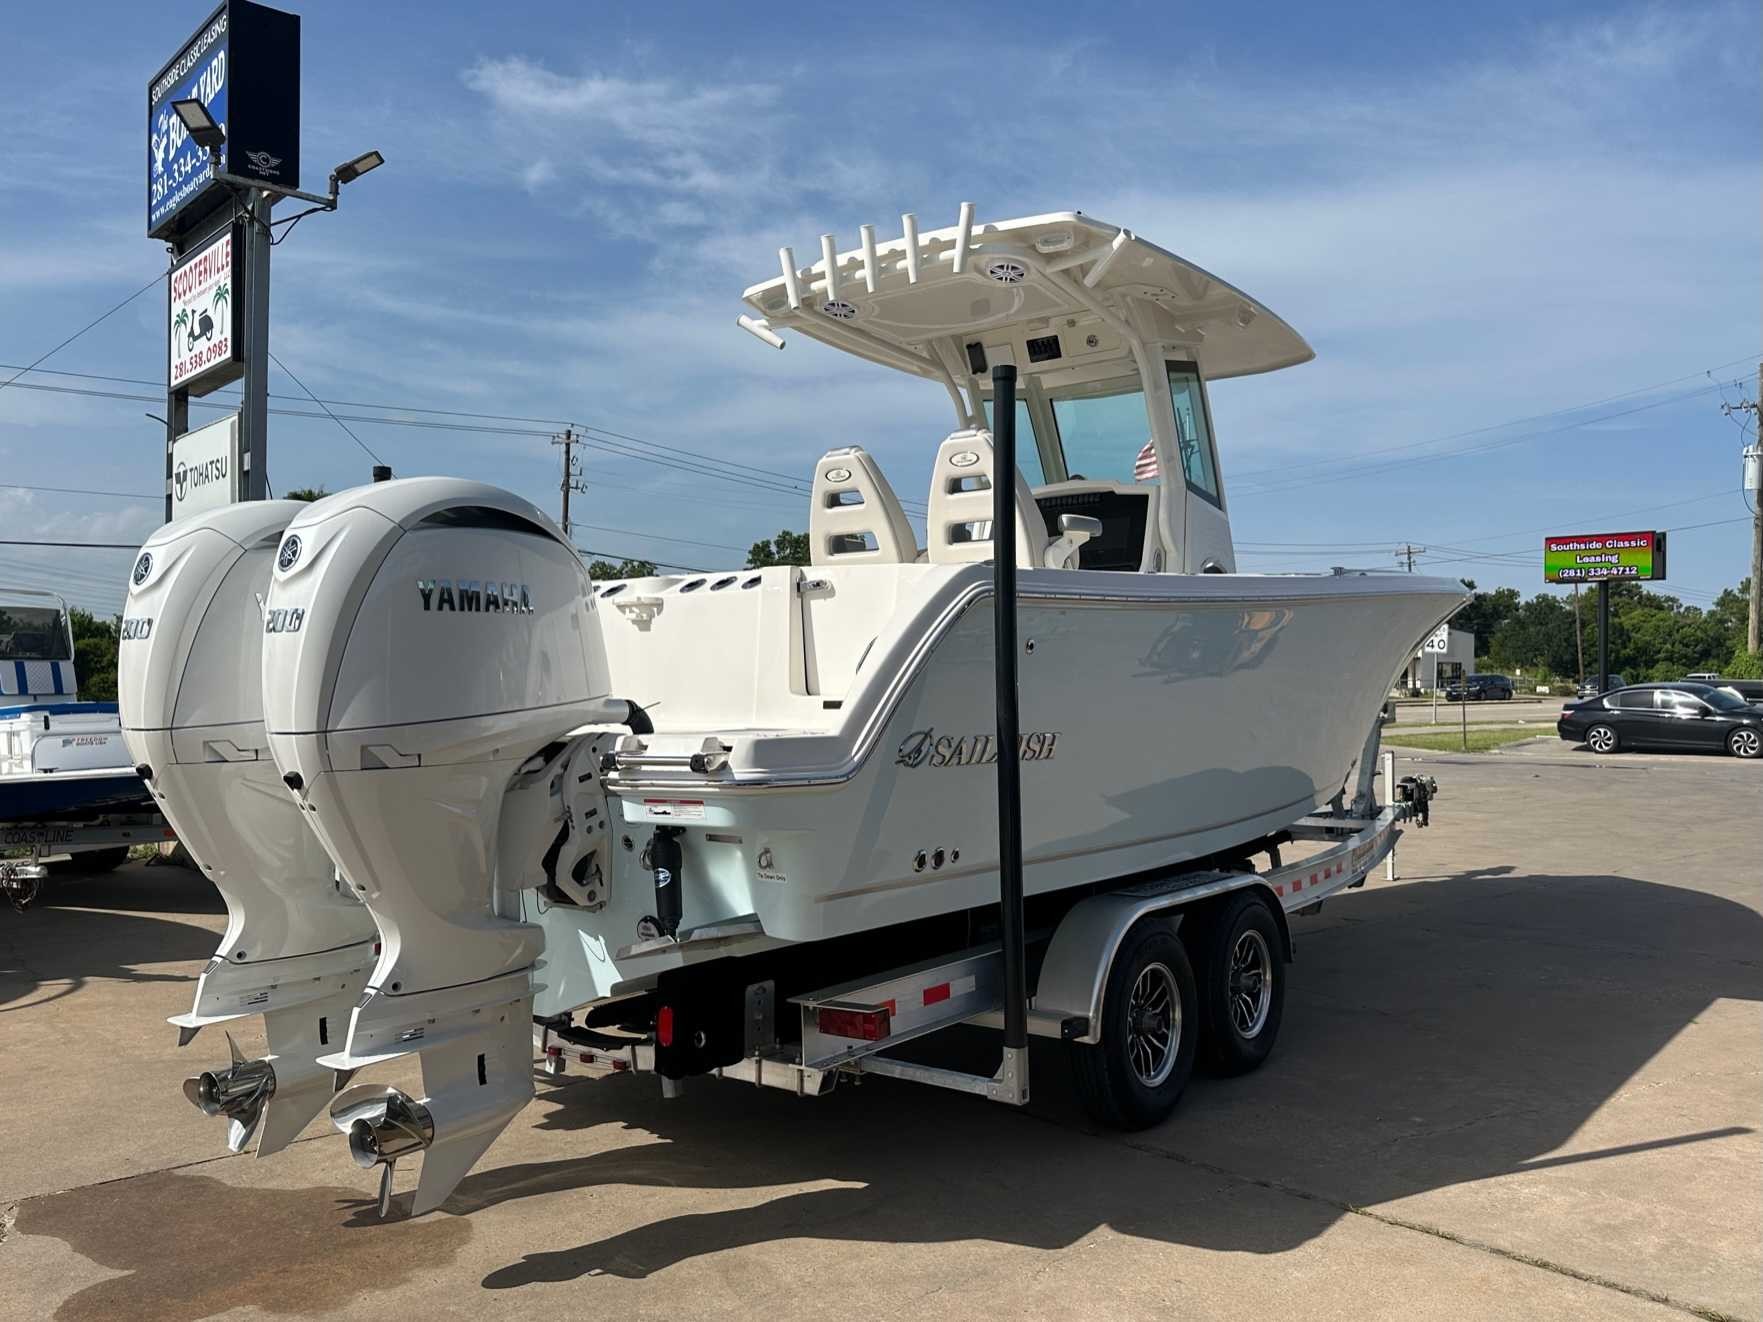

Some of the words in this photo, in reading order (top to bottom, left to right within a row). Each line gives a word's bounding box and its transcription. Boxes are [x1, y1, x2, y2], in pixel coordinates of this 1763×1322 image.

[152, 64, 180, 105] SOUTHSIDE
[180, 40, 201, 76] CLASSIC
[201, 14, 227, 53] LEASING
[173, 238, 232, 303] SCOOTERVILLE
[174, 337, 229, 381] 281.538.0983
[189, 456, 228, 489] TOHATSU
[1550, 542, 1603, 552] Southside
[1605, 538, 1648, 549] Classic
[1576, 553, 1619, 564] Leasing
[1559, 569, 1585, 578] (281)
[1588, 566, 1637, 577] 334-4712
[417, 579, 536, 616] YAMAHA
[1426, 639, 1446, 650] 40
[928, 732, 1062, 768] SAILISH
